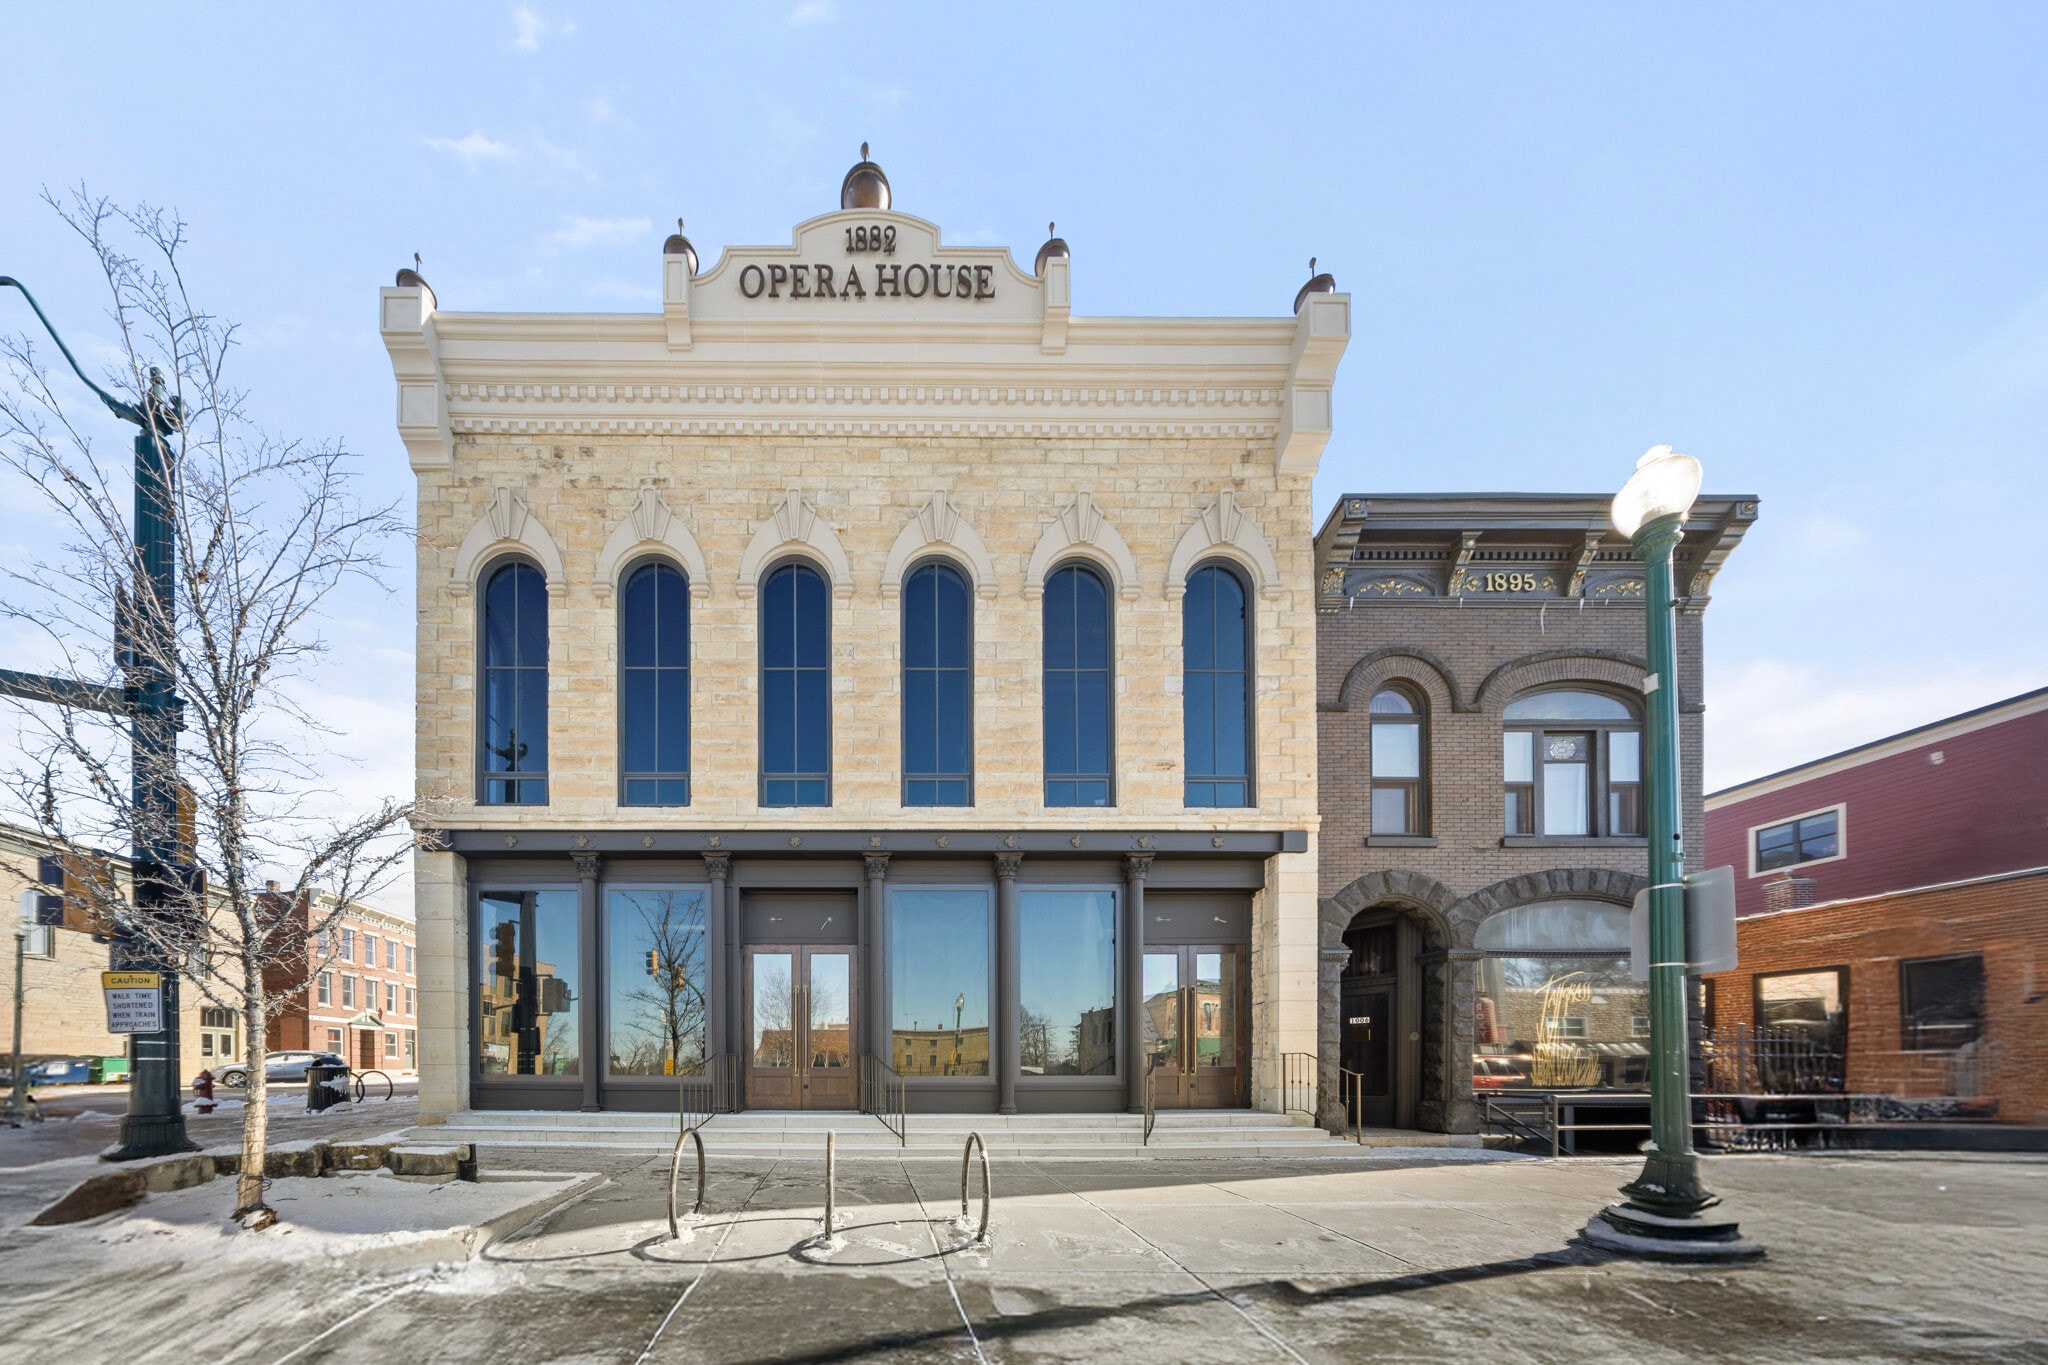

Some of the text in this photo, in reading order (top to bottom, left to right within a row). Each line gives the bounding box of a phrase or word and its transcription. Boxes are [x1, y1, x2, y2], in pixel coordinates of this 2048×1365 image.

[845, 225, 897, 254] 1882
[739, 264, 996, 299] OPERA HOUSE
[1485, 572, 1537, 592] 1895
[134, 992, 152, 1000] TIME
[112, 1001, 153, 1010] SHORTENED
[112, 1011, 131, 1019] WHEN
